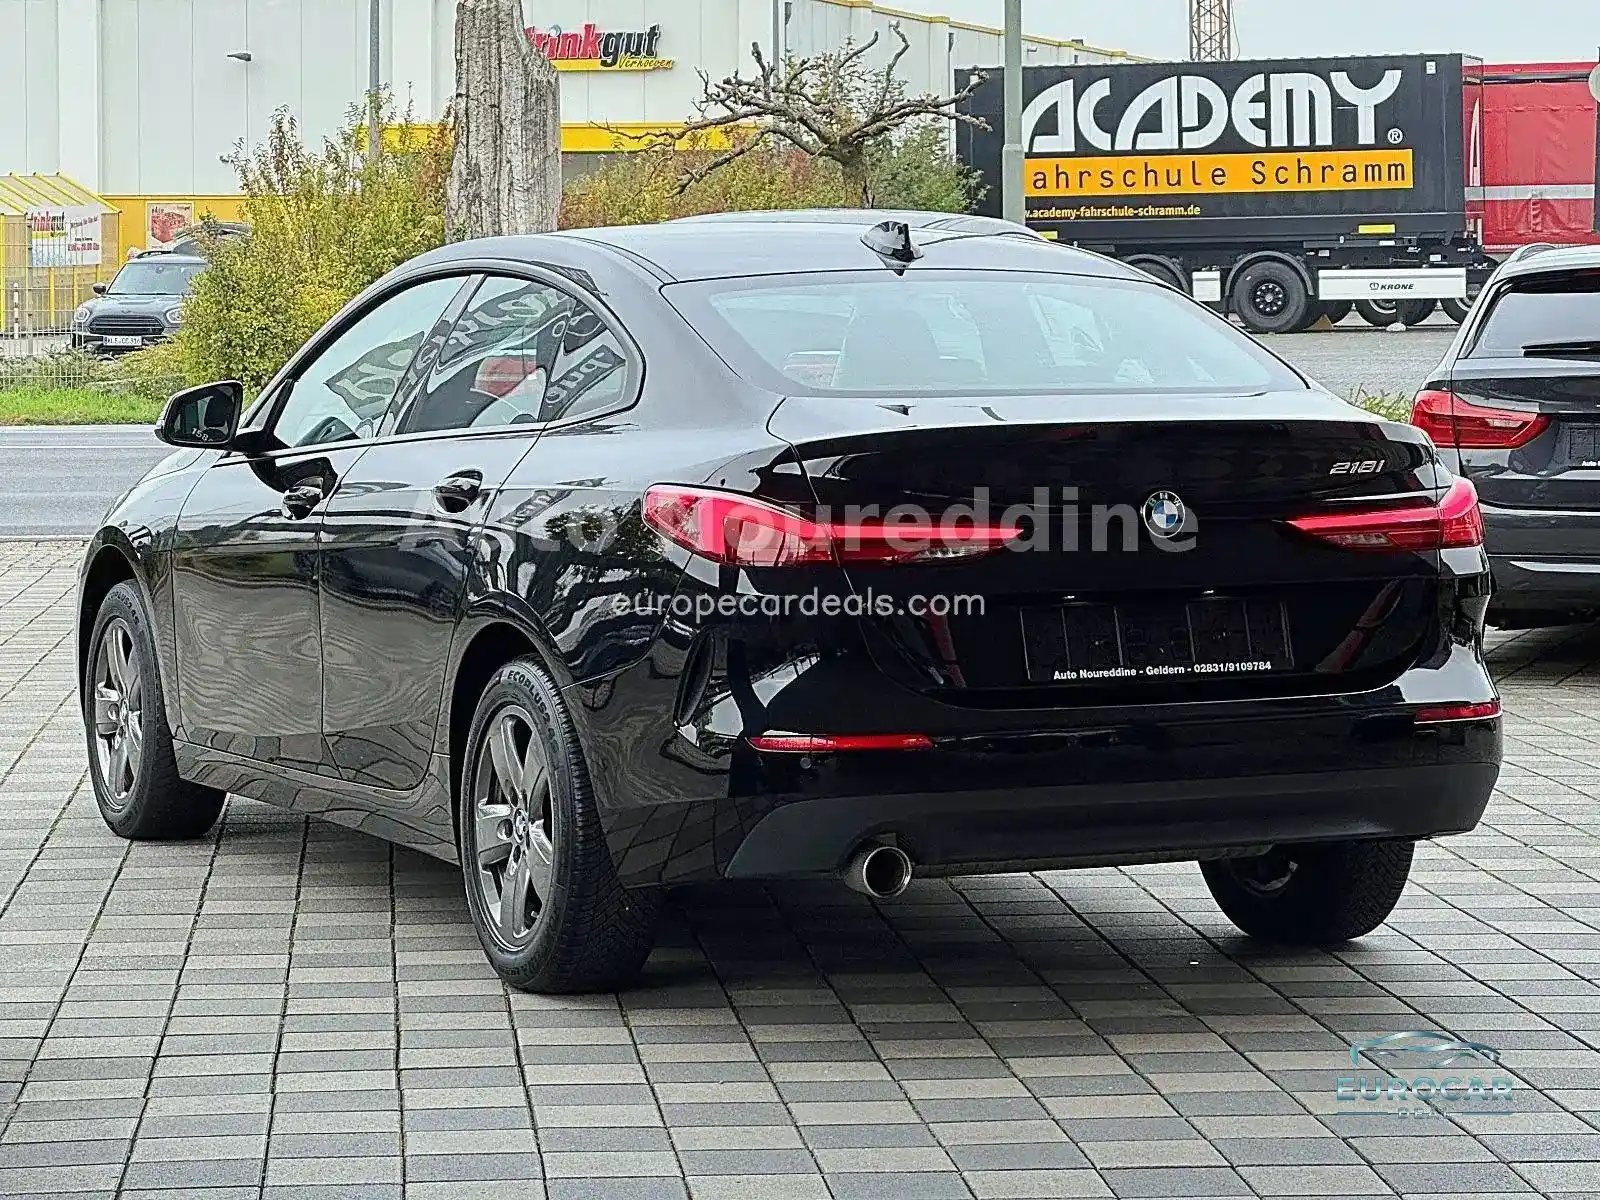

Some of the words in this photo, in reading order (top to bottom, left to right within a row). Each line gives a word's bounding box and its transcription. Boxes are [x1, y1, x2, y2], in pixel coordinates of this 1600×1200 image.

[1022, 69, 1402, 153] ACADEMY
[1032, 160, 1227, 190] ahrschule
[1251, 158, 1406, 185] Schramm
[1148, 492, 1182, 507] BMW
[1053, 670, 1077, 680] Auto
[1080, 667, 1137, 679] Noureddine
[1146, 665, 1185, 676] Geldern
[1194, 661, 1272, 673] 02831/9109784
